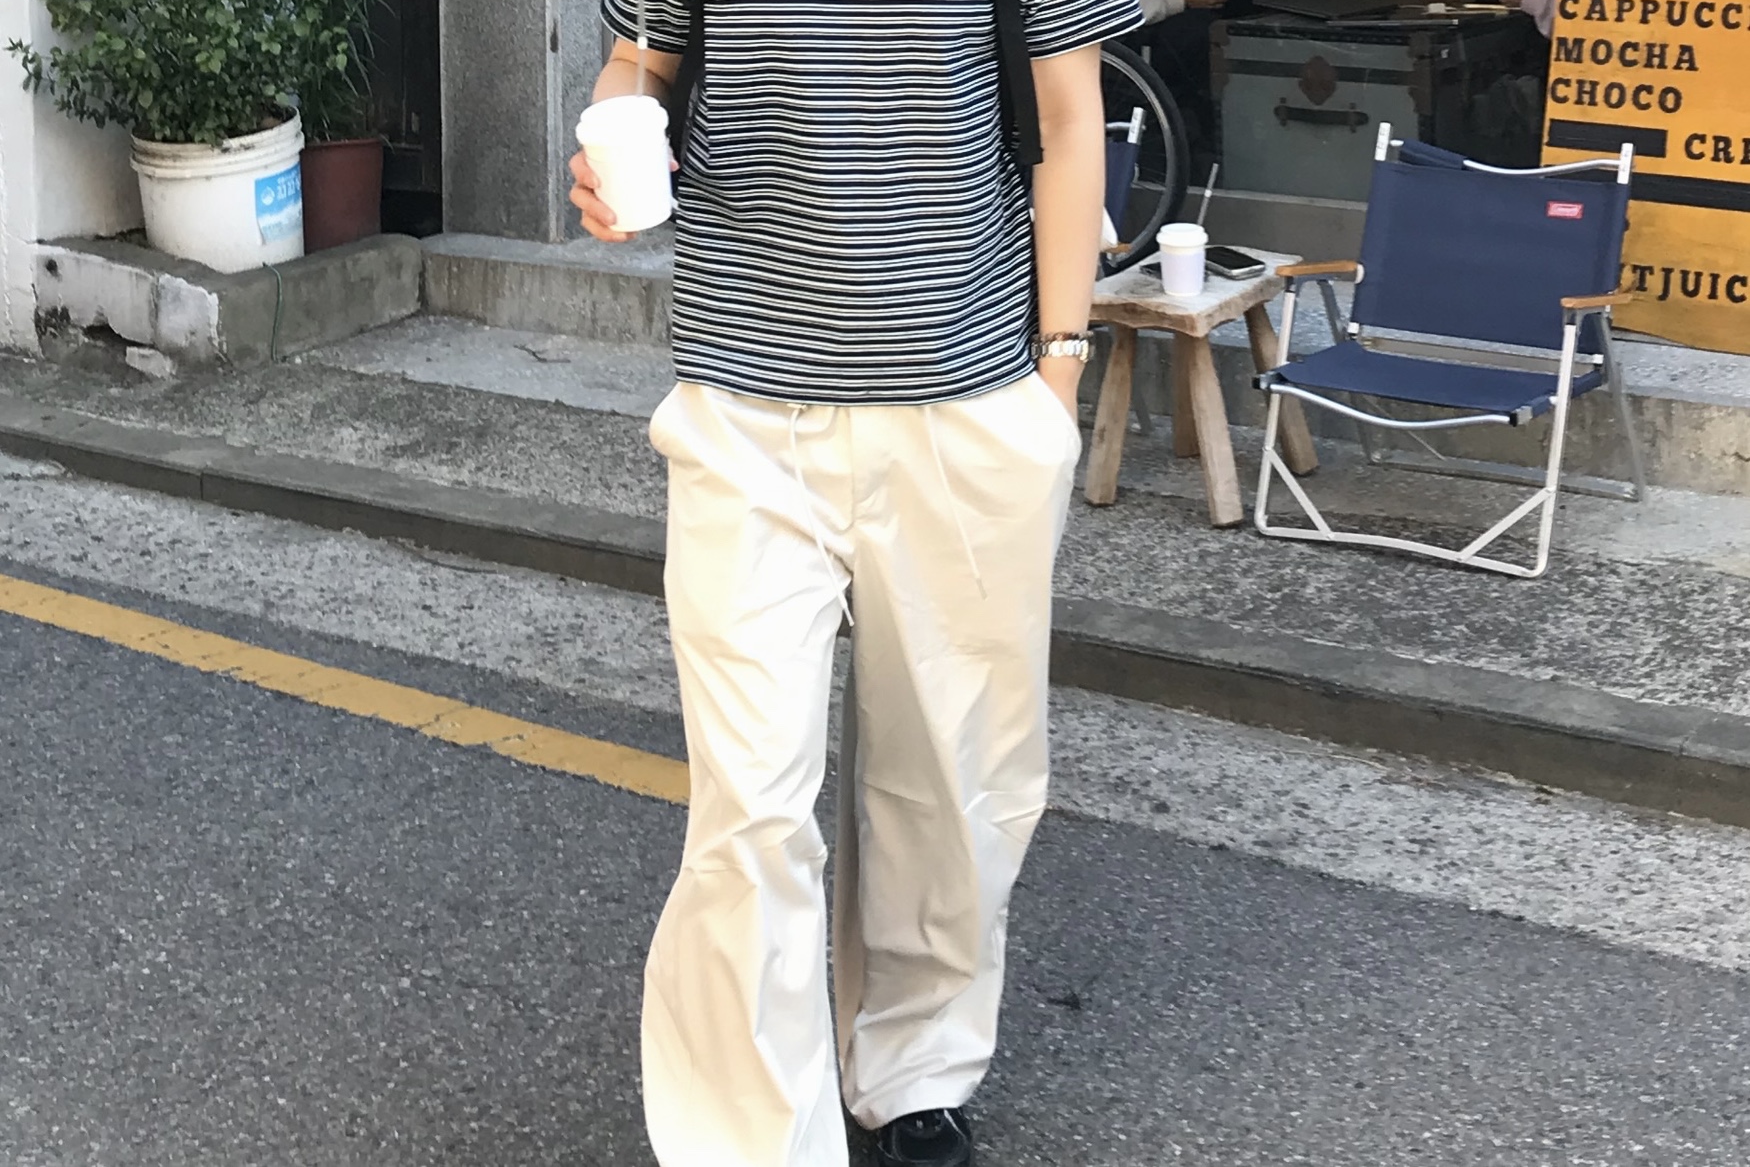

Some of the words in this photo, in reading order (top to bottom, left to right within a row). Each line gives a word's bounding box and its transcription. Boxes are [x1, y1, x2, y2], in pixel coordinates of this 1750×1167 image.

[1554, 36, 1699, 72] MOCHA
[1550, 77, 1683, 114] CHOCO
[1620, 262, 1748, 304] TJUIC
